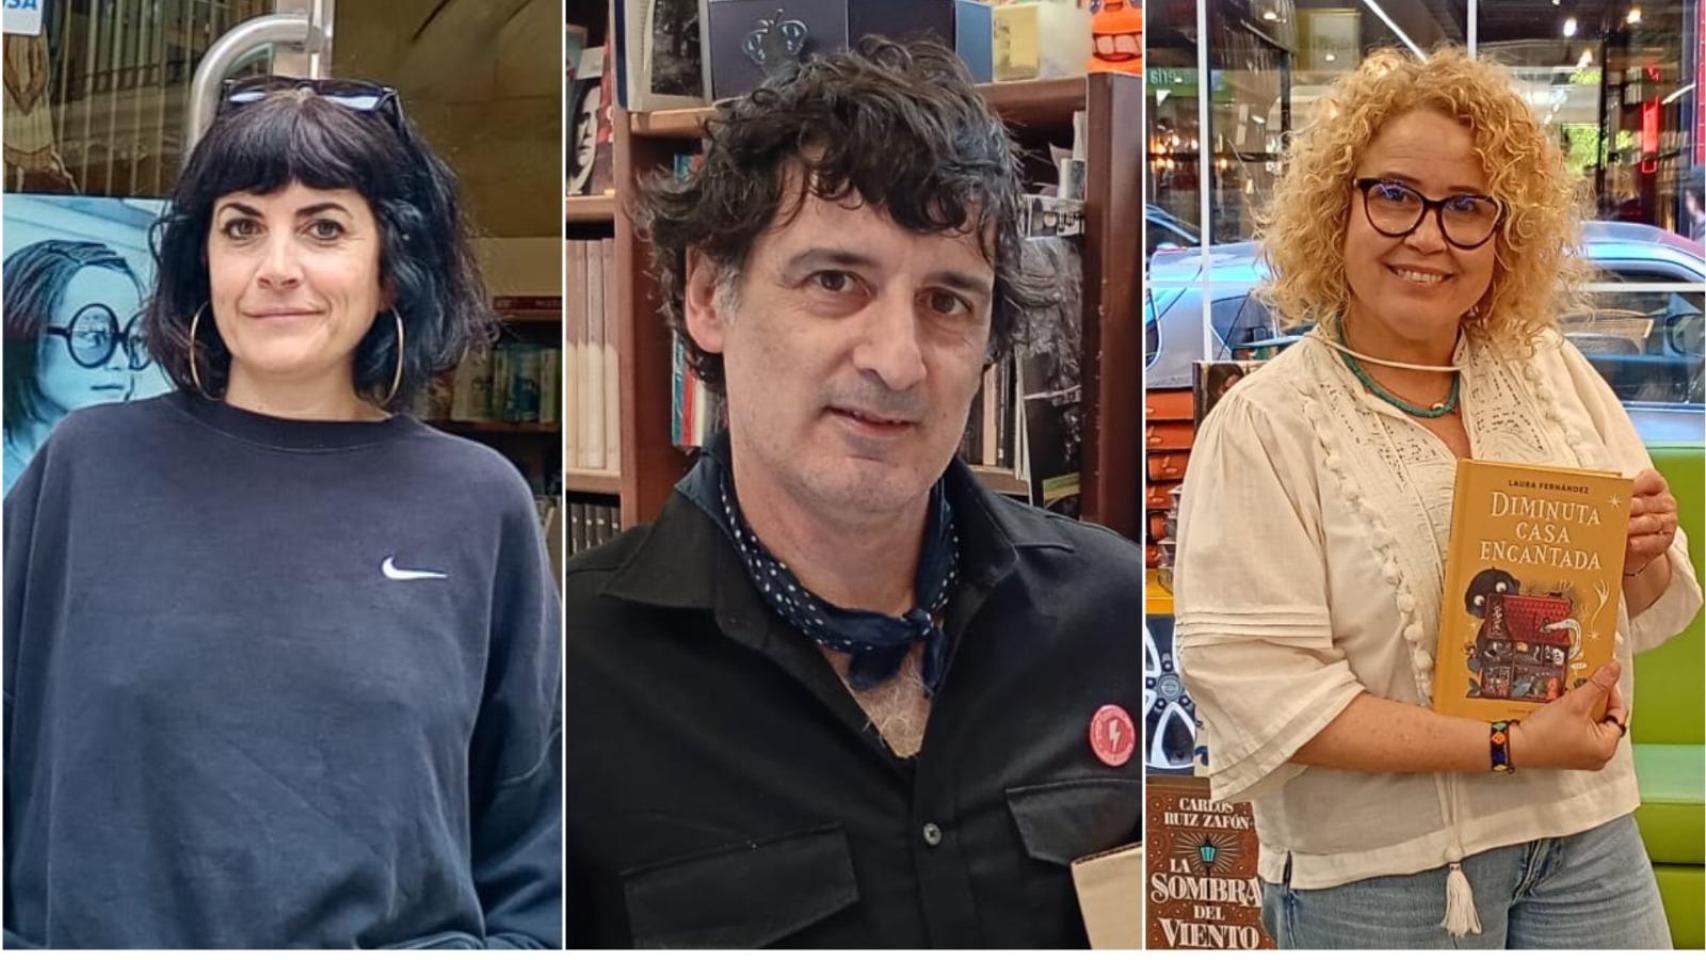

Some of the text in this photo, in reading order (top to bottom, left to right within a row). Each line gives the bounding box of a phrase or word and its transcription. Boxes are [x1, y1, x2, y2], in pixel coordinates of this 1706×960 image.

[1508, 479, 1589, 494] LAURA FERNÁNDEZ
[1491, 491, 1601, 525] DIMINUTA
[1515, 521, 1571, 543] CASA
[1480, 541, 1601, 570] ENCANTADA
[1179, 798, 1234, 813] CARLOS
[1164, 812, 1250, 829] RUIZ ZAFÓN
[1170, 859, 1191, 873] LA
[1151, 873, 1262, 907] SOMBRA
[1194, 905, 1225, 921] DEL
[1158, 917, 1260, 949] VIENTO
